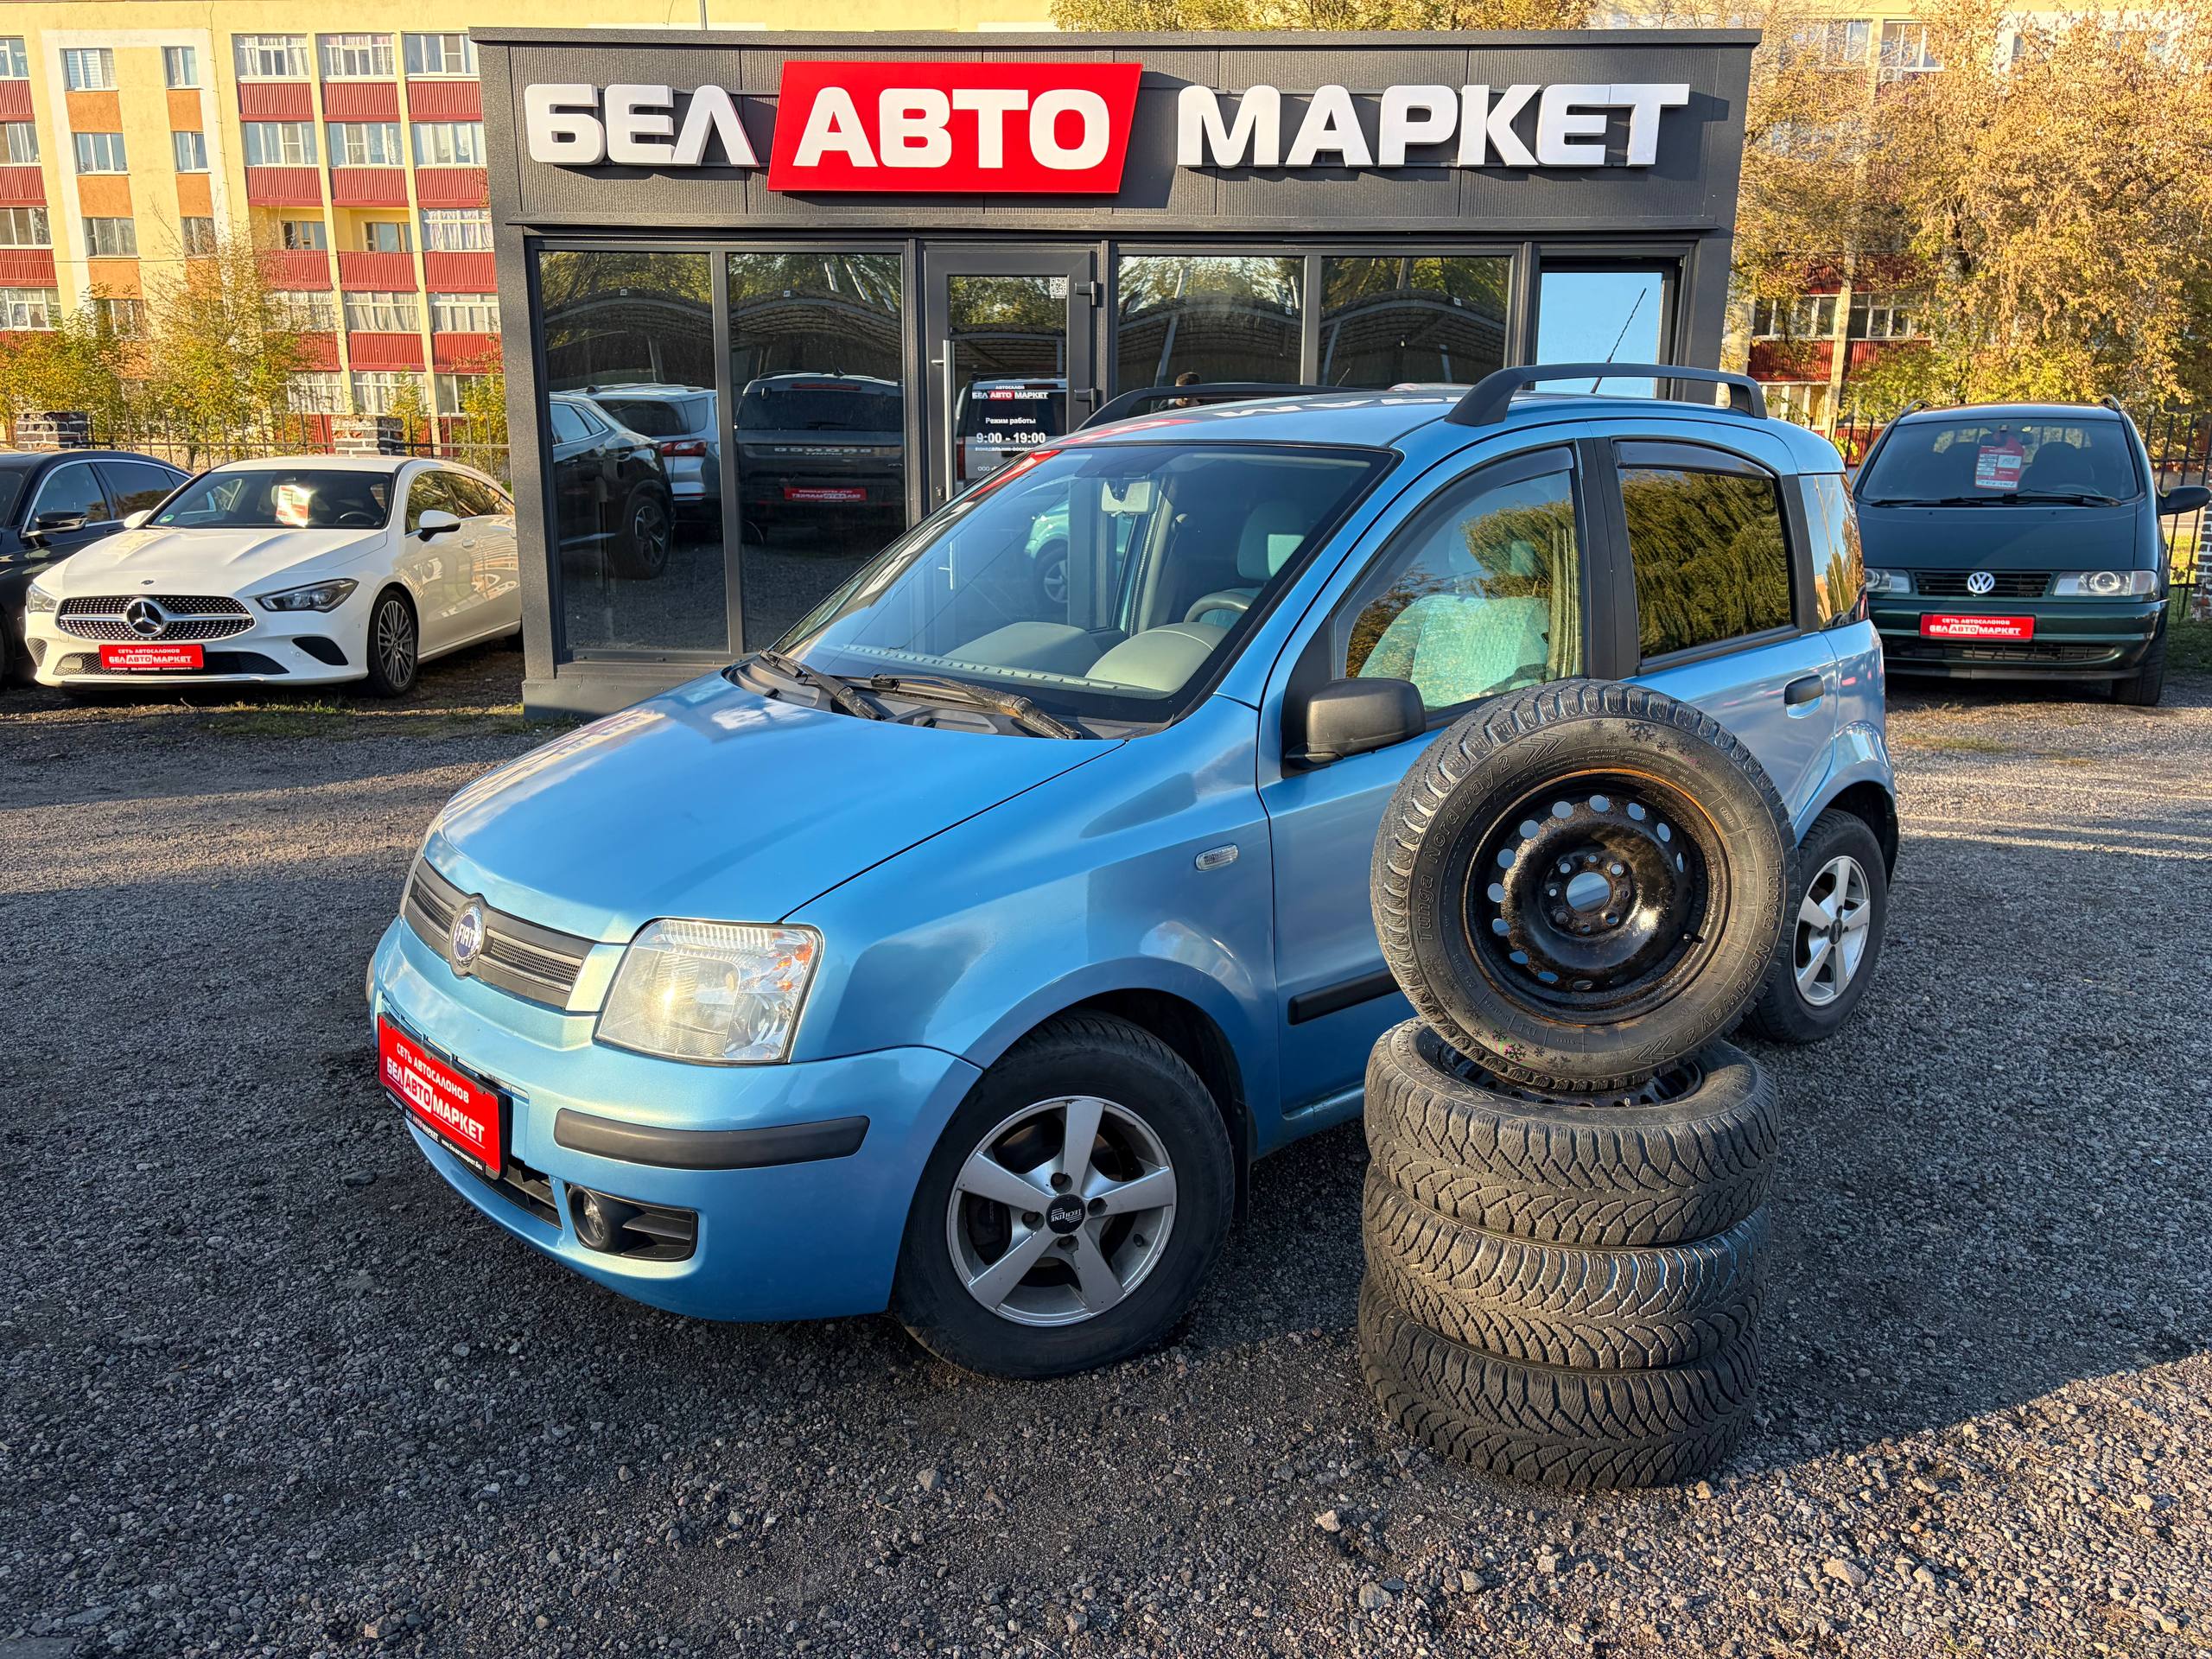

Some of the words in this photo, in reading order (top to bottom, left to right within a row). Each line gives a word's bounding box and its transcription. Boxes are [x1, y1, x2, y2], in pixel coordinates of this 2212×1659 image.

[524, 84, 760, 168] БЕЛ
[792, 86, 1110, 170] АВТО
[1177, 83, 1690, 168] МАРКЕТ
[976, 432, 1002, 443] 9:00
[1013, 432, 1046, 443] 19:00
[1497, 754, 1510, 774] 2
[1423, 767, 1494, 864] Nordway
[1416, 874, 1434, 943] Tunga
[1763, 860, 1782, 931] Tunga
[456, 923, 475, 949] FIAT
[1700, 941, 1770, 1033] Nordway
[1684, 1028, 1697, 1044] 2
[387, 1056, 404, 1086] БЕЛ
[404, 1076, 432, 1108] АВТО
[433, 1095, 485, 1143] МАРКЕТ
[397, 1042, 412, 1065] СЕТЬ
[414, 1057, 470, 1103] АВТОСАЛОНОВ
